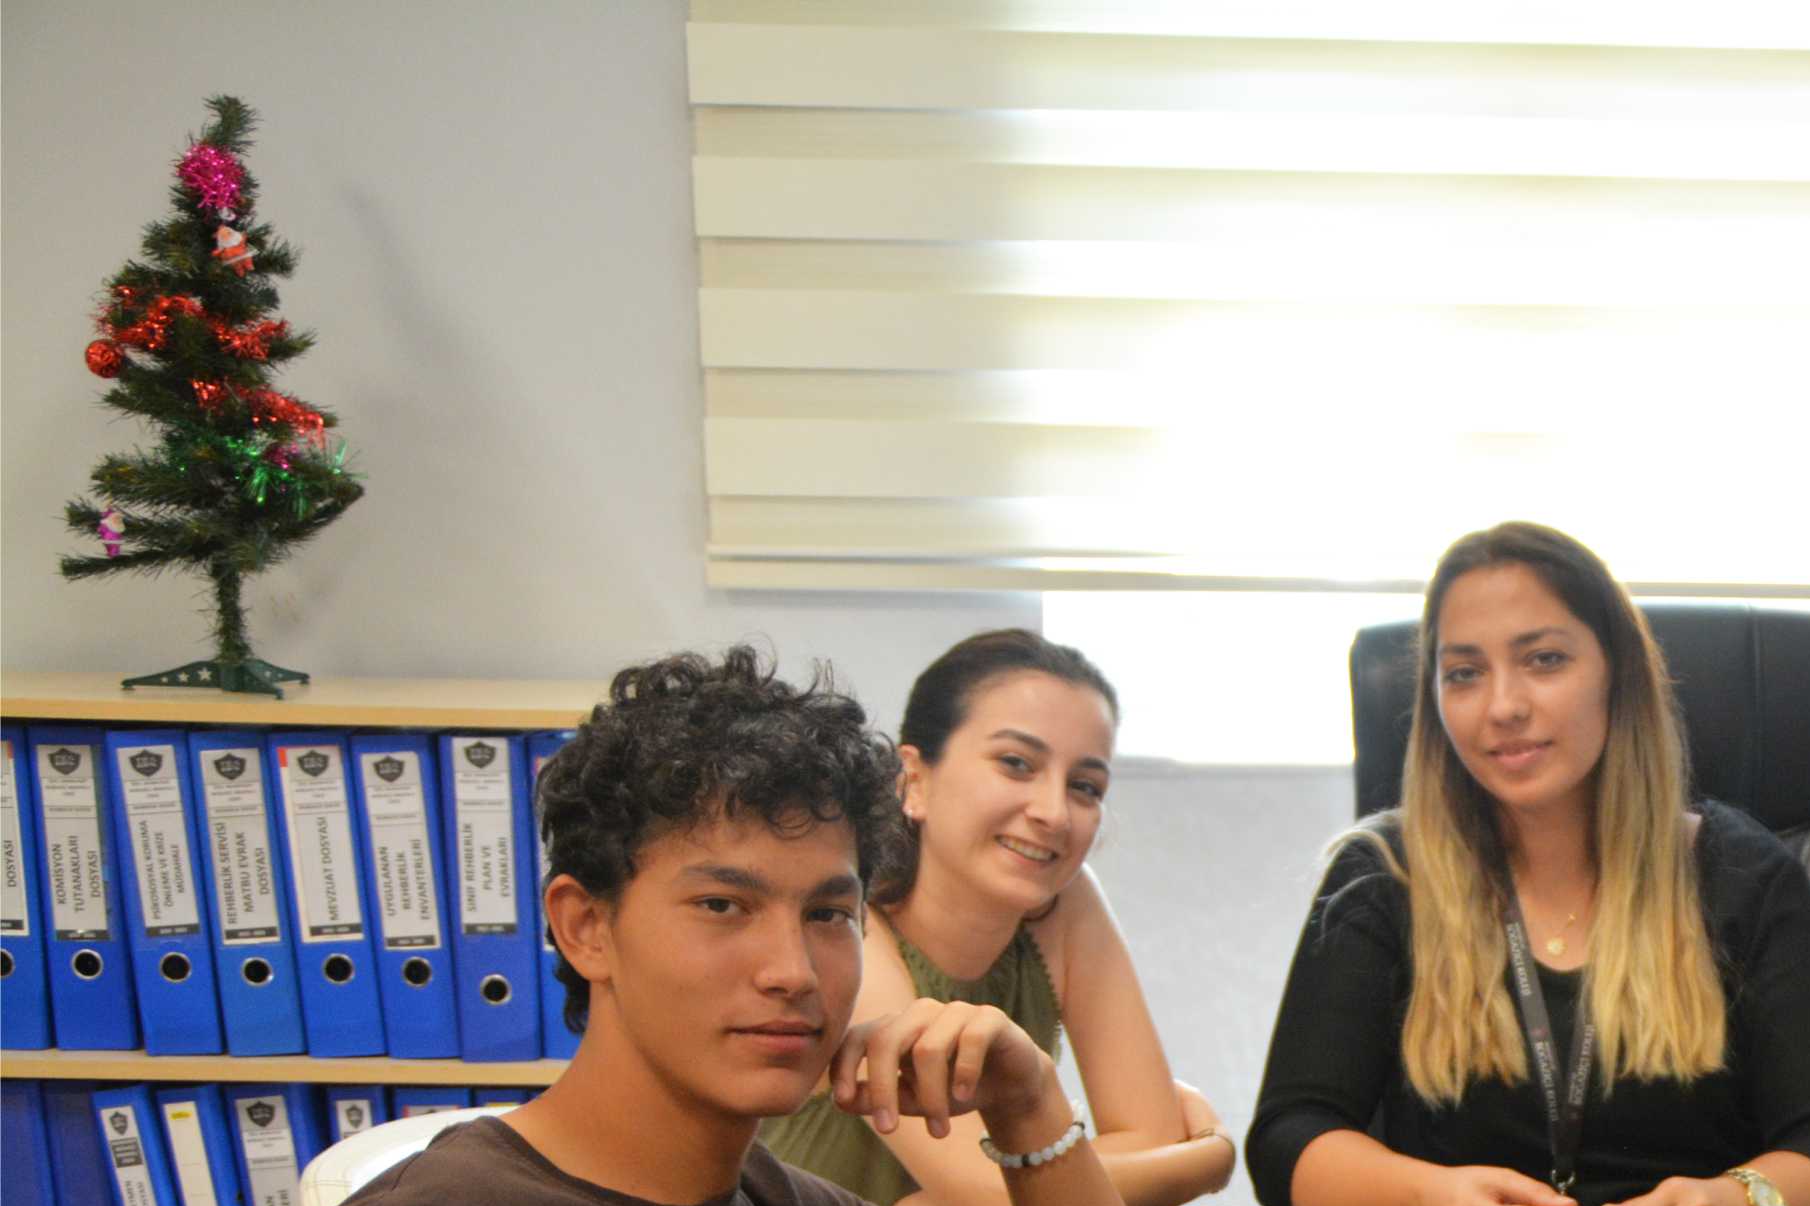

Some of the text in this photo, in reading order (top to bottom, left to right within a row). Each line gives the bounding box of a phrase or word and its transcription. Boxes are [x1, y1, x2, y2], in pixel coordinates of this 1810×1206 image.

[4, 840, 17, 888] DOSYASI
[317, 816, 332, 865] DOSYASI
[498, 837, 510, 897] EVRAKLARI
[51, 843, 66, 904] KOMİSYON
[68, 835, 85, 912] TUTANAKLARI
[87, 850, 101, 898] DOSYASI
[214, 822, 238, 925] REHBERLİK SERVİSİ
[235, 832, 254, 913] MATBU EVRAK
[255, 847, 270, 895] DOSYASI
[324, 868, 339, 921] MEVZUAT
[379, 846, 396, 917] UYGULANAN
[396, 851, 411, 910] REHBERLİK
[410, 839, 430, 920] ENVANTERLERİ
[481, 861, 492, 890] PLAN
